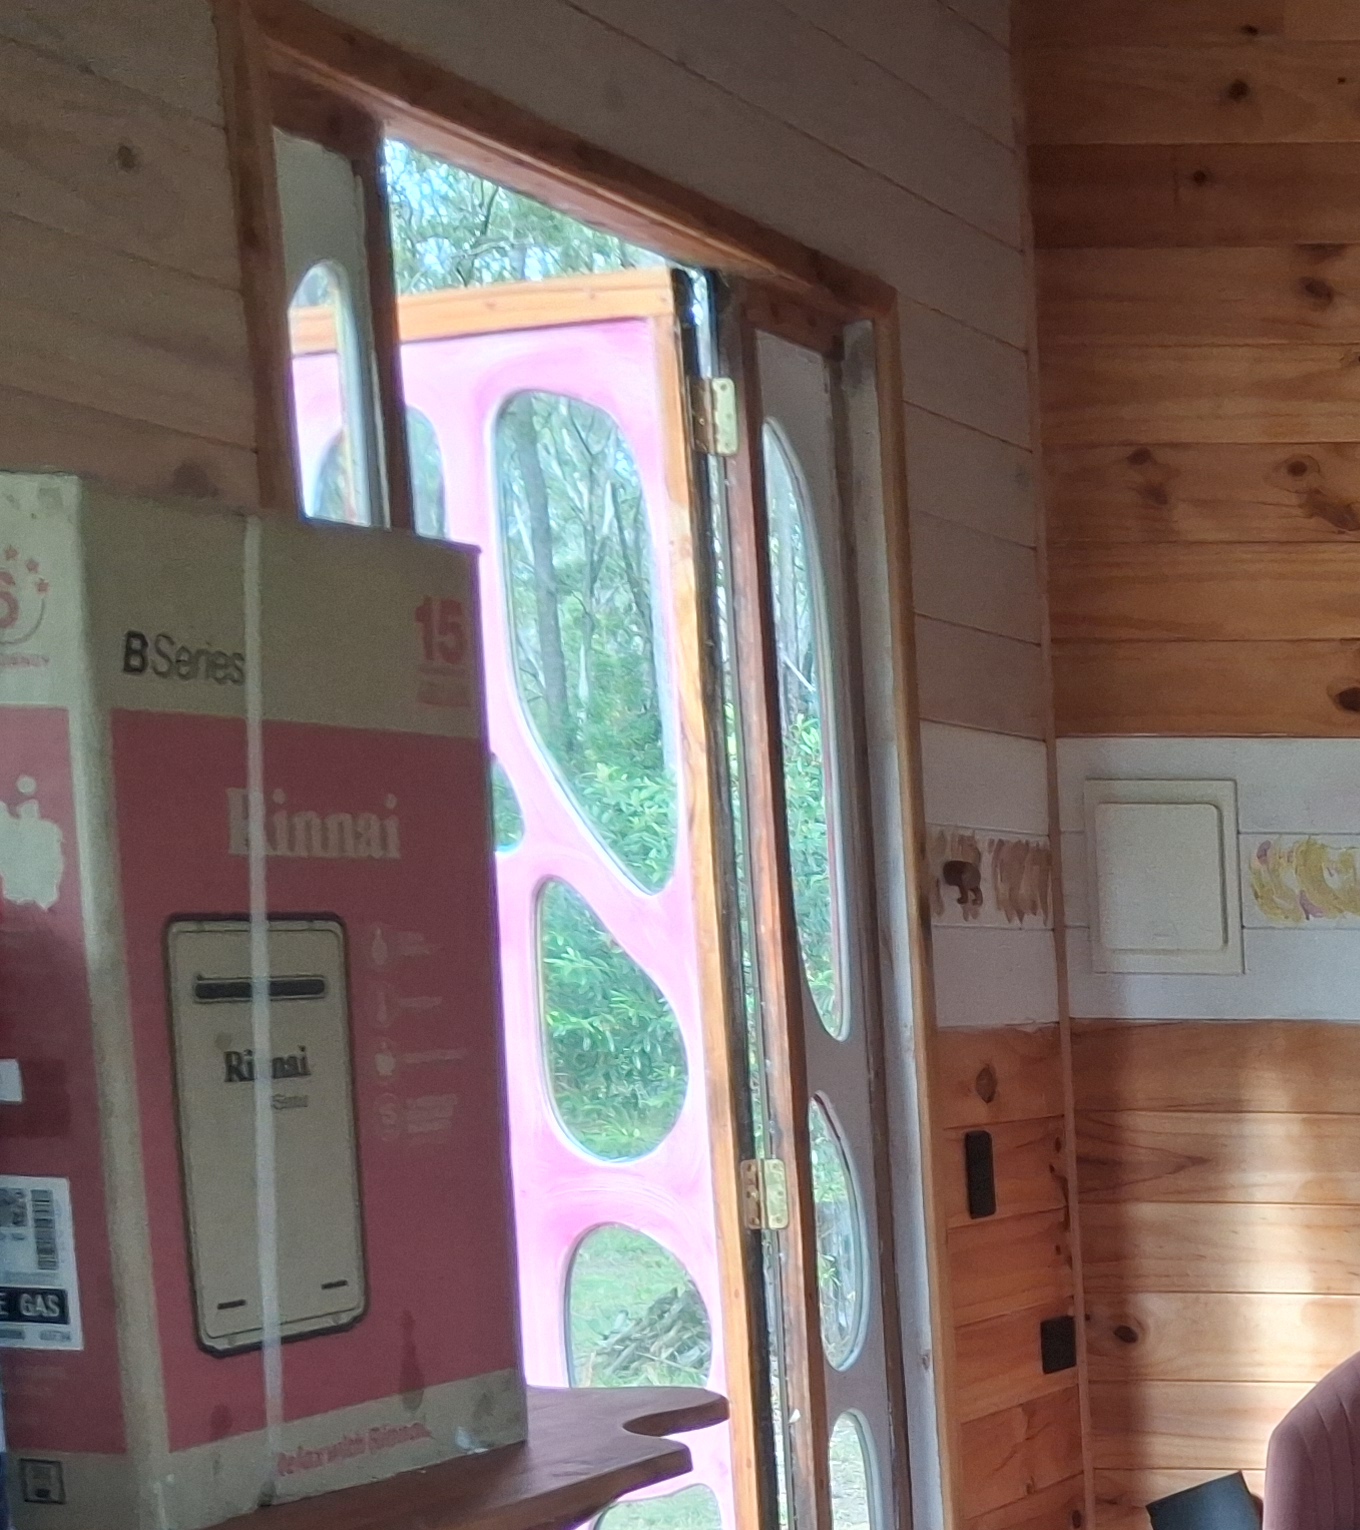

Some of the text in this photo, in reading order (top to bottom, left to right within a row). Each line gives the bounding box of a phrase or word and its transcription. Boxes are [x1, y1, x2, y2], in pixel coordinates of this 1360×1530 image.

[415, 596, 469, 664] 15
[223, 1045, 312, 1083] Rinai
[19, 1293, 60, 1317] GAS
